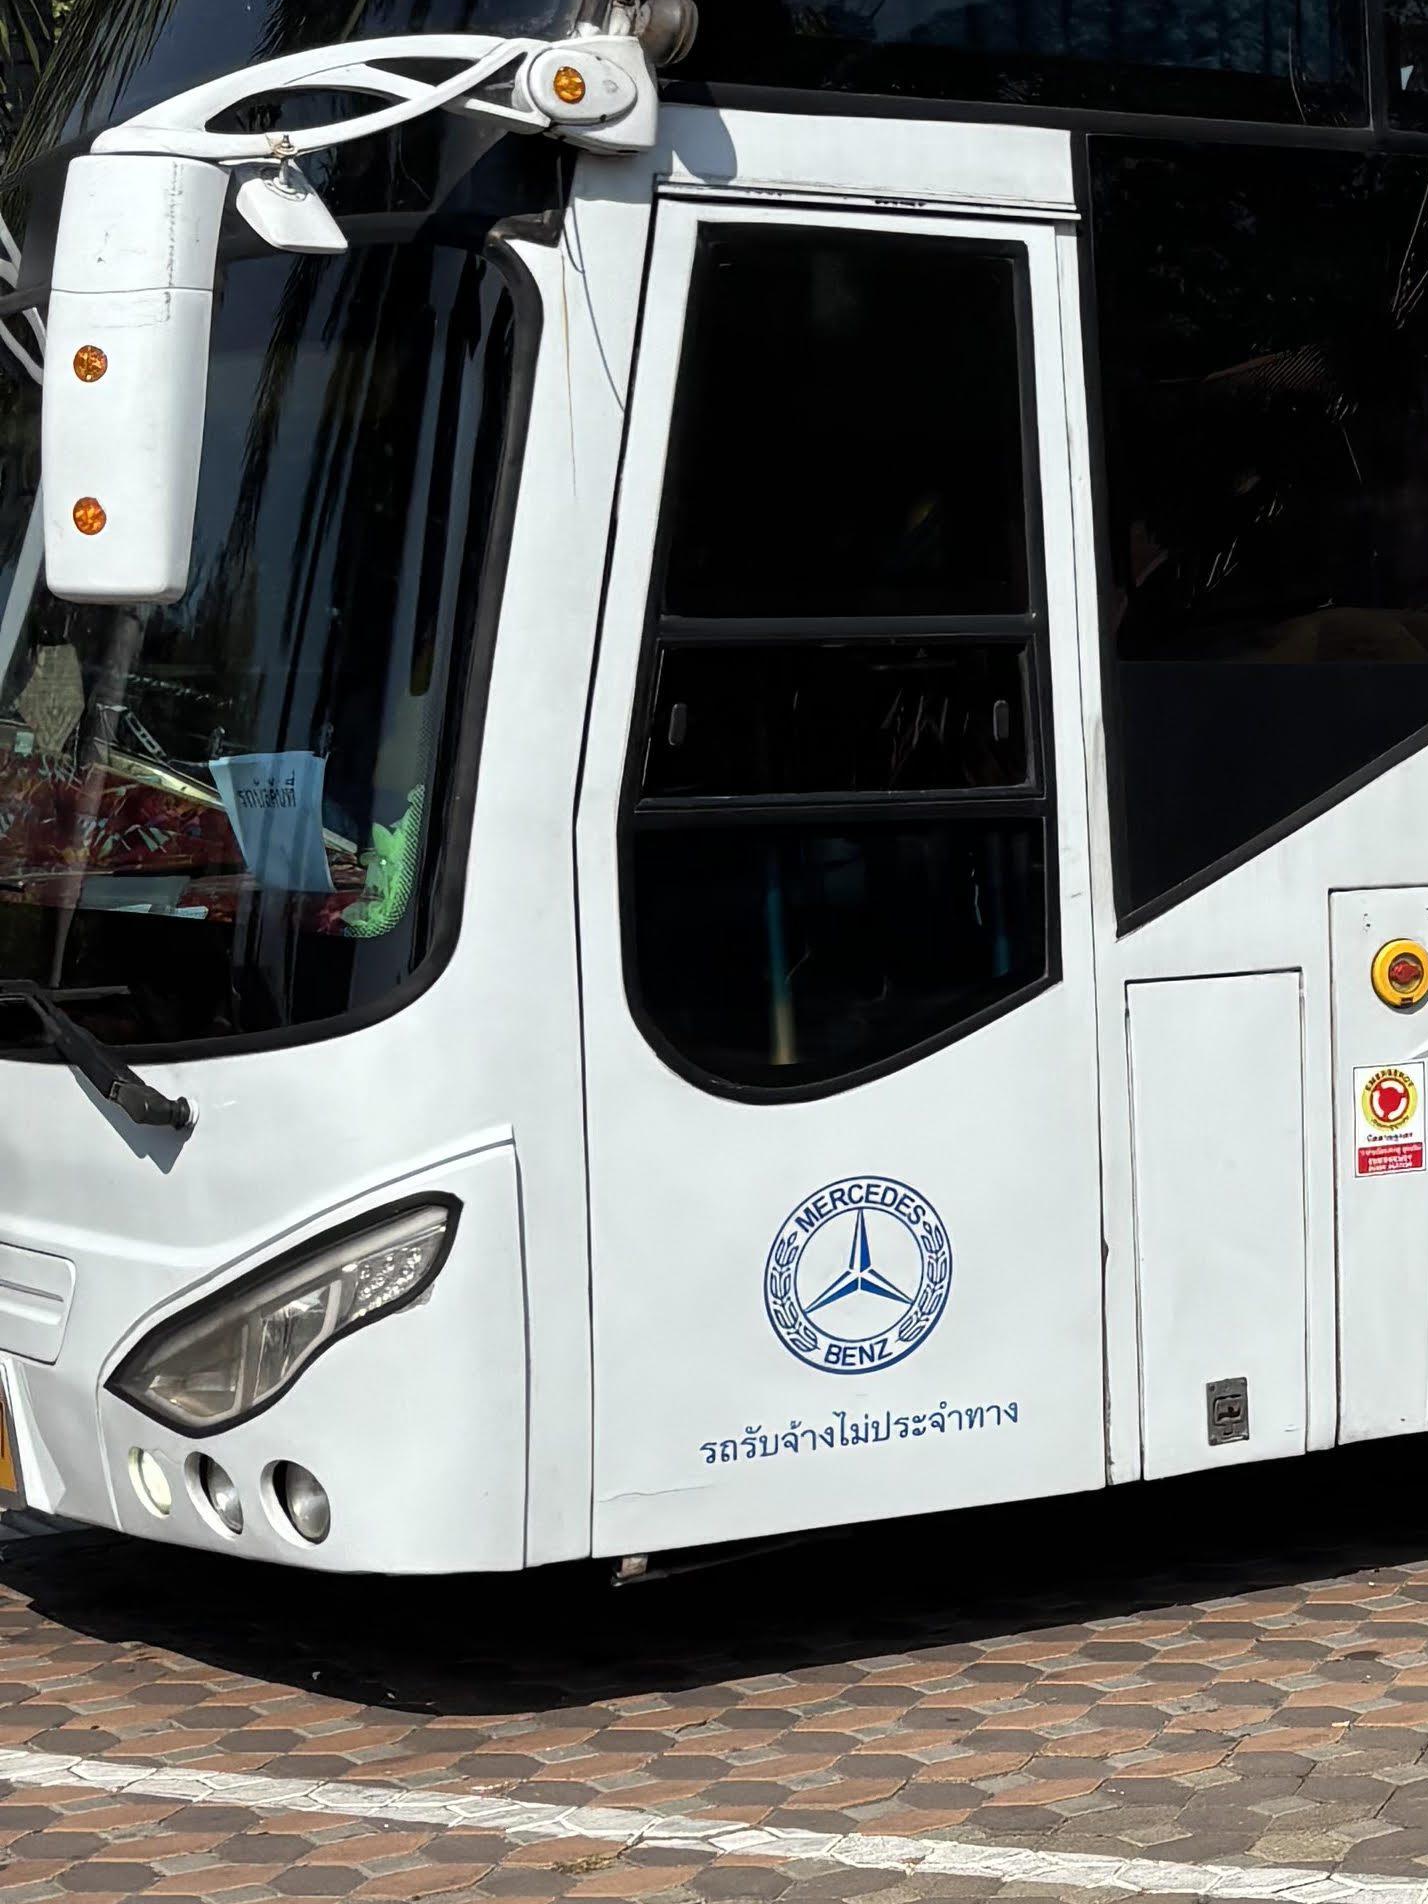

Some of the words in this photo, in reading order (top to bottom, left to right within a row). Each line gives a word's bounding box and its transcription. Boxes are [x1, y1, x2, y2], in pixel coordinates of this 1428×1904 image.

[794, 1183, 926, 1233] MERCEDES
[823, 1338, 893, 1366] BENZ
[699, 1400, 1019, 1464] รถรับจ้างไม่ประจำทาง
